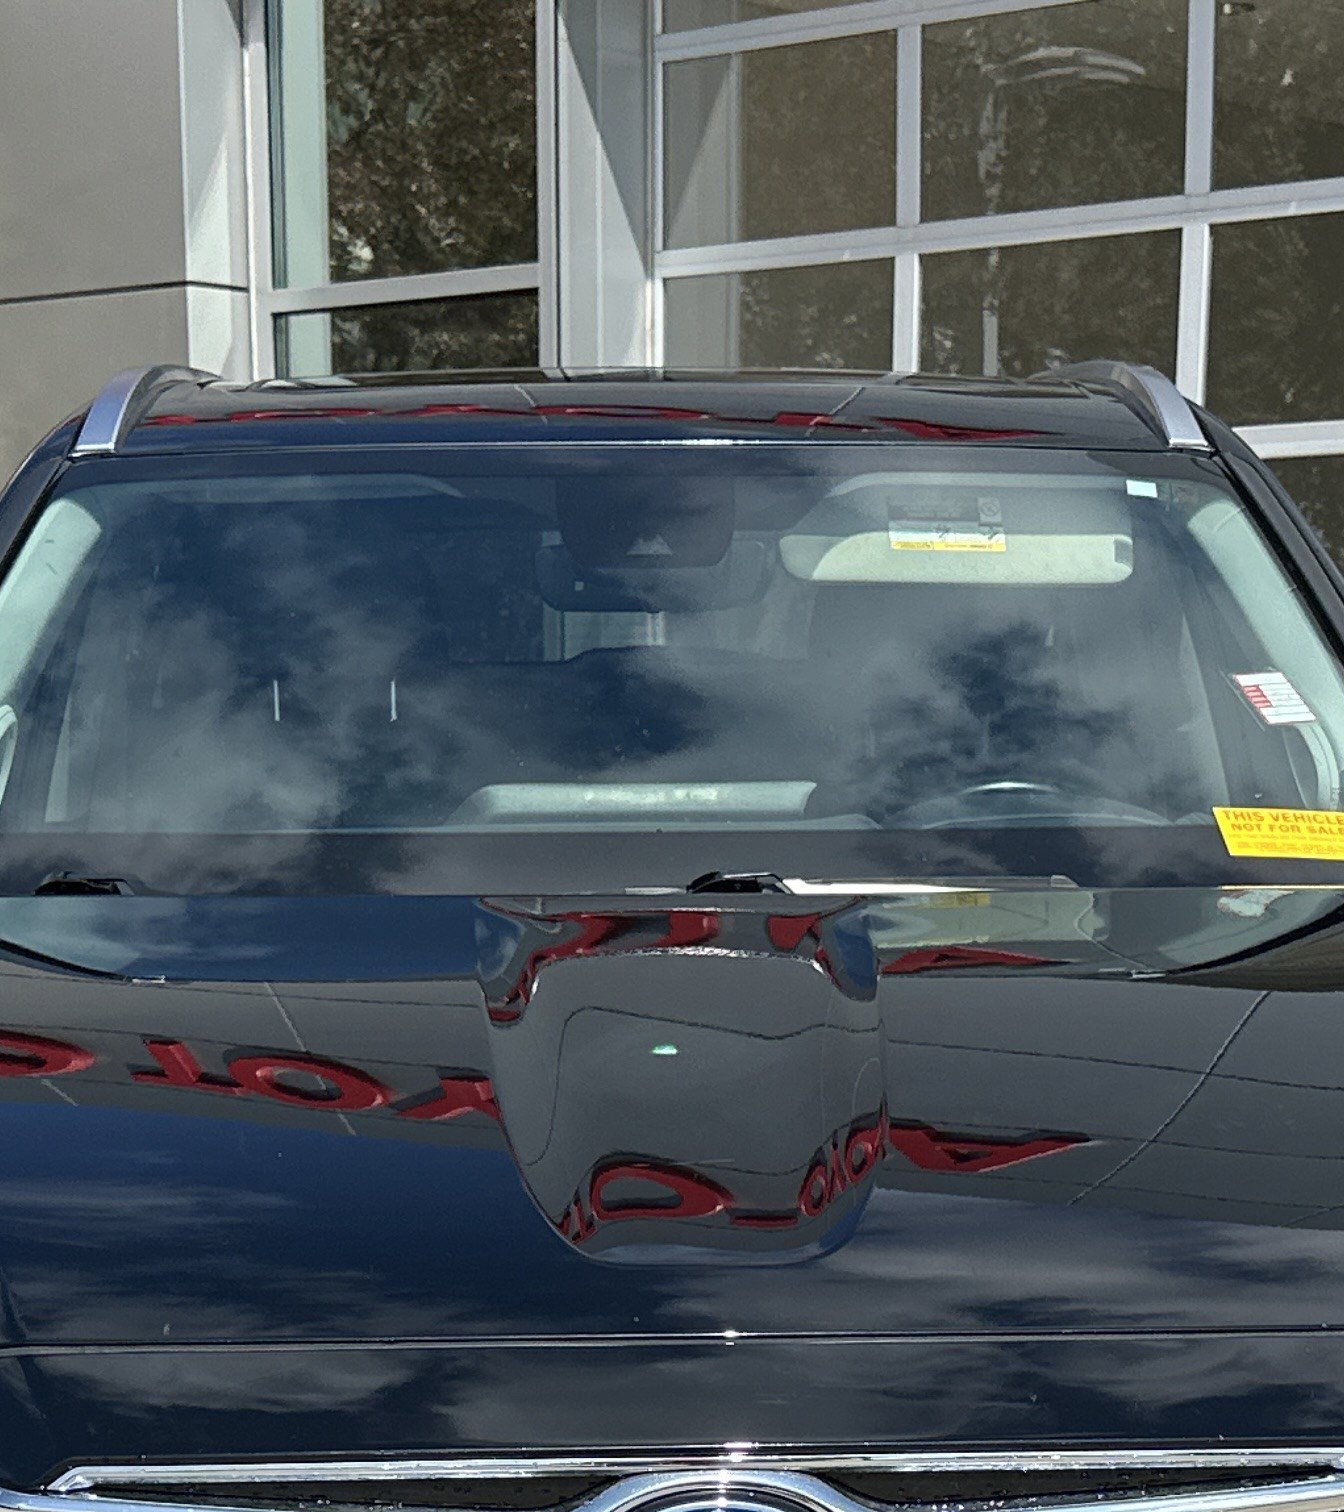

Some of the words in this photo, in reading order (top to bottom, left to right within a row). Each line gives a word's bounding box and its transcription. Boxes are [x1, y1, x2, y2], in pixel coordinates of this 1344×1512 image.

[1222, 810, 1265, 823] THIS
[1230, 823, 1262, 833] NOT
[1268, 823, 1302, 834] FOR
